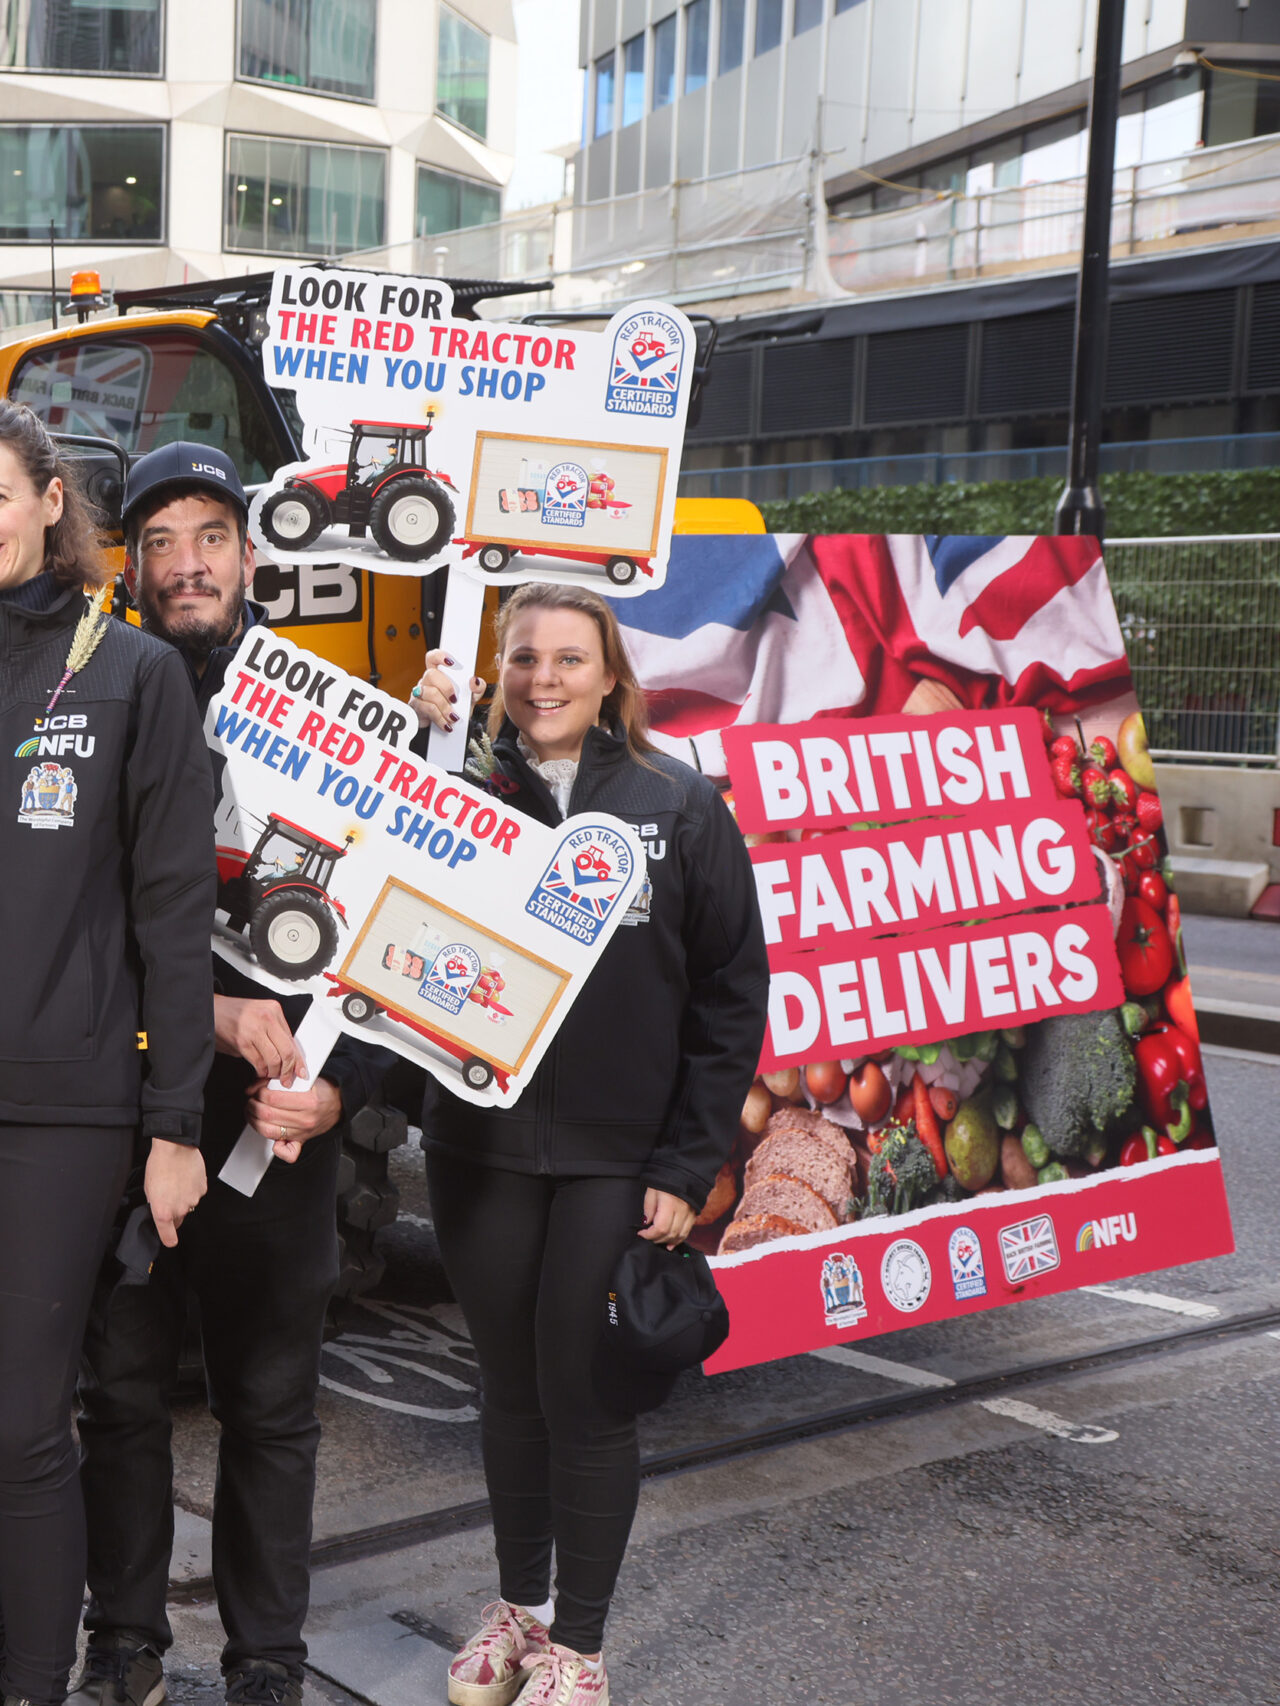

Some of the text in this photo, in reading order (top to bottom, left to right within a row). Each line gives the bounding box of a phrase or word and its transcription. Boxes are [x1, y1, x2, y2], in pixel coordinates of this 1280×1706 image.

[281, 275, 443, 320] LOOK FOR
[278, 310, 576, 370] THE RED TRACTOR
[620, 316, 680, 345] RED TRACTOR
[273, 346, 545, 402] WHEN YOU SHOP
[607, 399, 674, 416] STANDARDS
[612, 388, 671, 404] CERTIFIED
[192, 462, 226, 480] JCB
[545, 510, 581, 519] CERTIFIED
[246, 553, 357, 620] CB
[245, 637, 407, 747] LOOK FOR
[34, 714, 88, 732] JCB
[38, 734, 96, 758] NFU
[230, 671, 521, 856] THE RED TRACTOR
[214, 705, 477, 870] WHEN YOU SHOP
[752, 724, 1030, 820] BRITISH
[569, 831, 592, 848] RED
[597, 831, 628, 874] TRACTOR
[752, 818, 1076, 945] FARMING
[528, 900, 594, 943] STANDARDS
[538, 892, 597, 930] CERTIFIED
[425, 983, 460, 1005] CERTIFIED
[768, 924, 1098, 1056] DELIVERS
[1092, 1212, 1137, 1248] NFU
